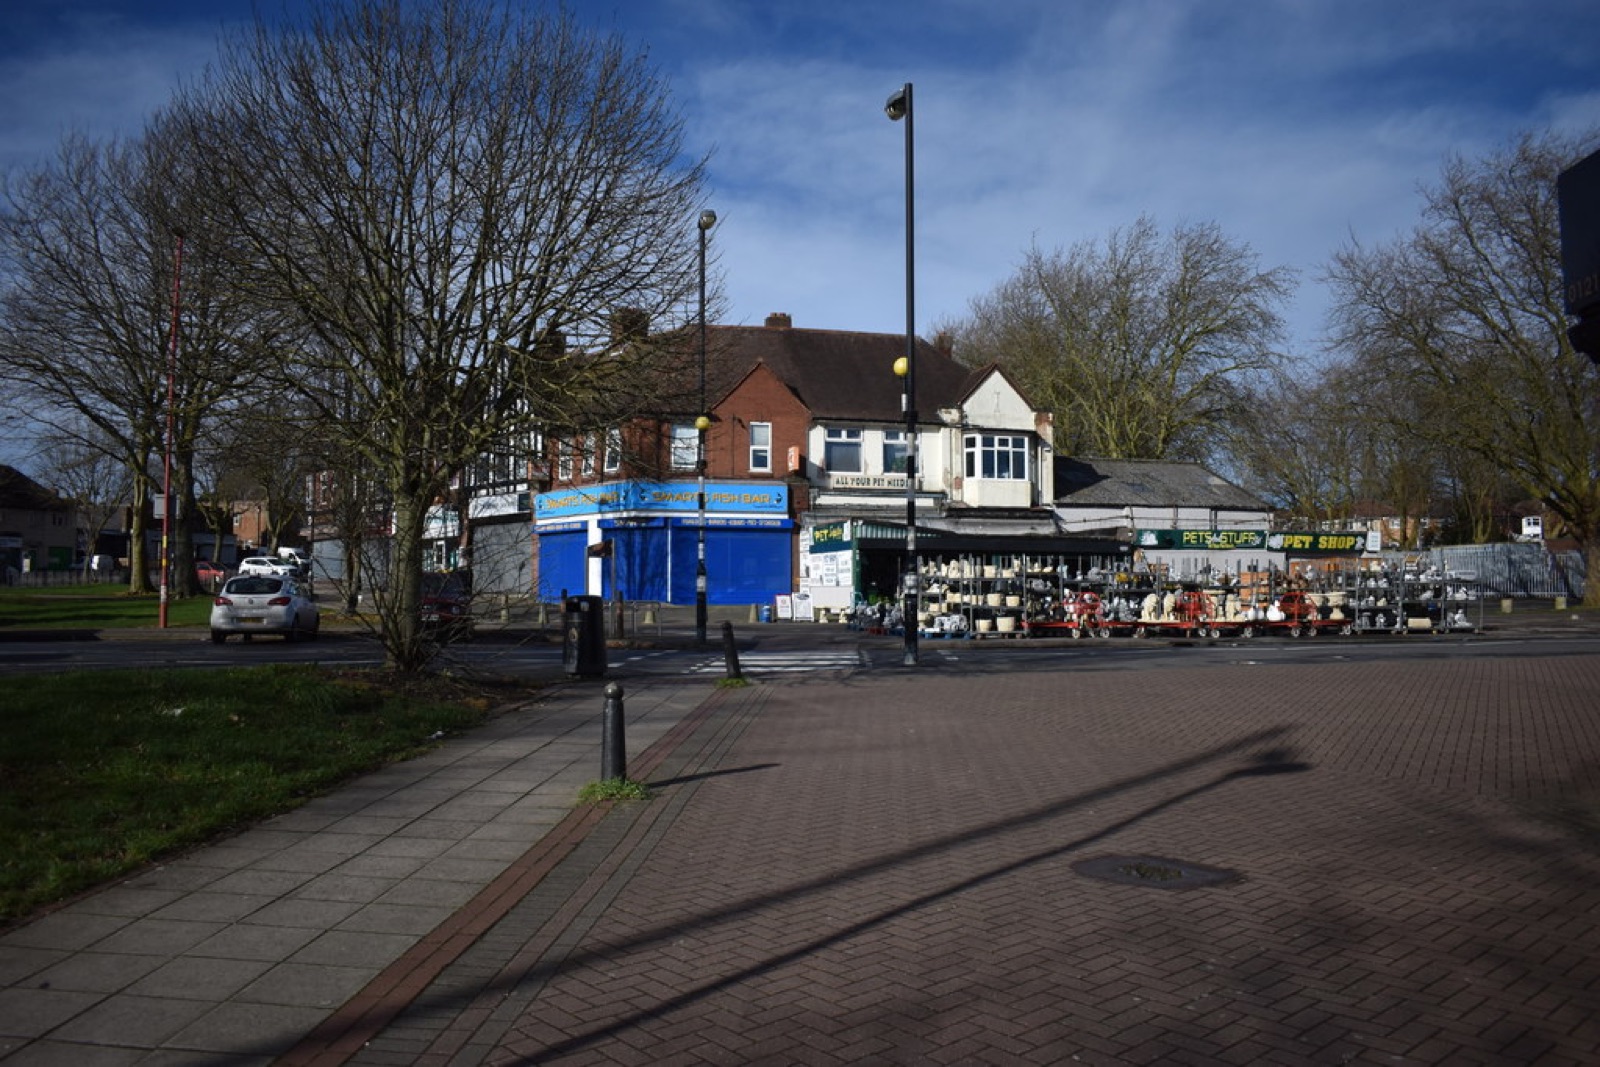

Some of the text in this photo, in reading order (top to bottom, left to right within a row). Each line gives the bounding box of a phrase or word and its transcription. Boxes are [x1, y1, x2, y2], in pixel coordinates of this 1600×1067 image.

[836, 476, 848, 485] ALL
[850, 477, 871, 486] YOUR
[873, 478, 885, 487] PET
[712, 493, 738, 504] FISH
[743, 493, 770, 504] BAR
[1182, 532, 1212, 544] PETS
[1283, 535, 1314, 549] PET
[1318, 535, 1356, 549] SHOP
